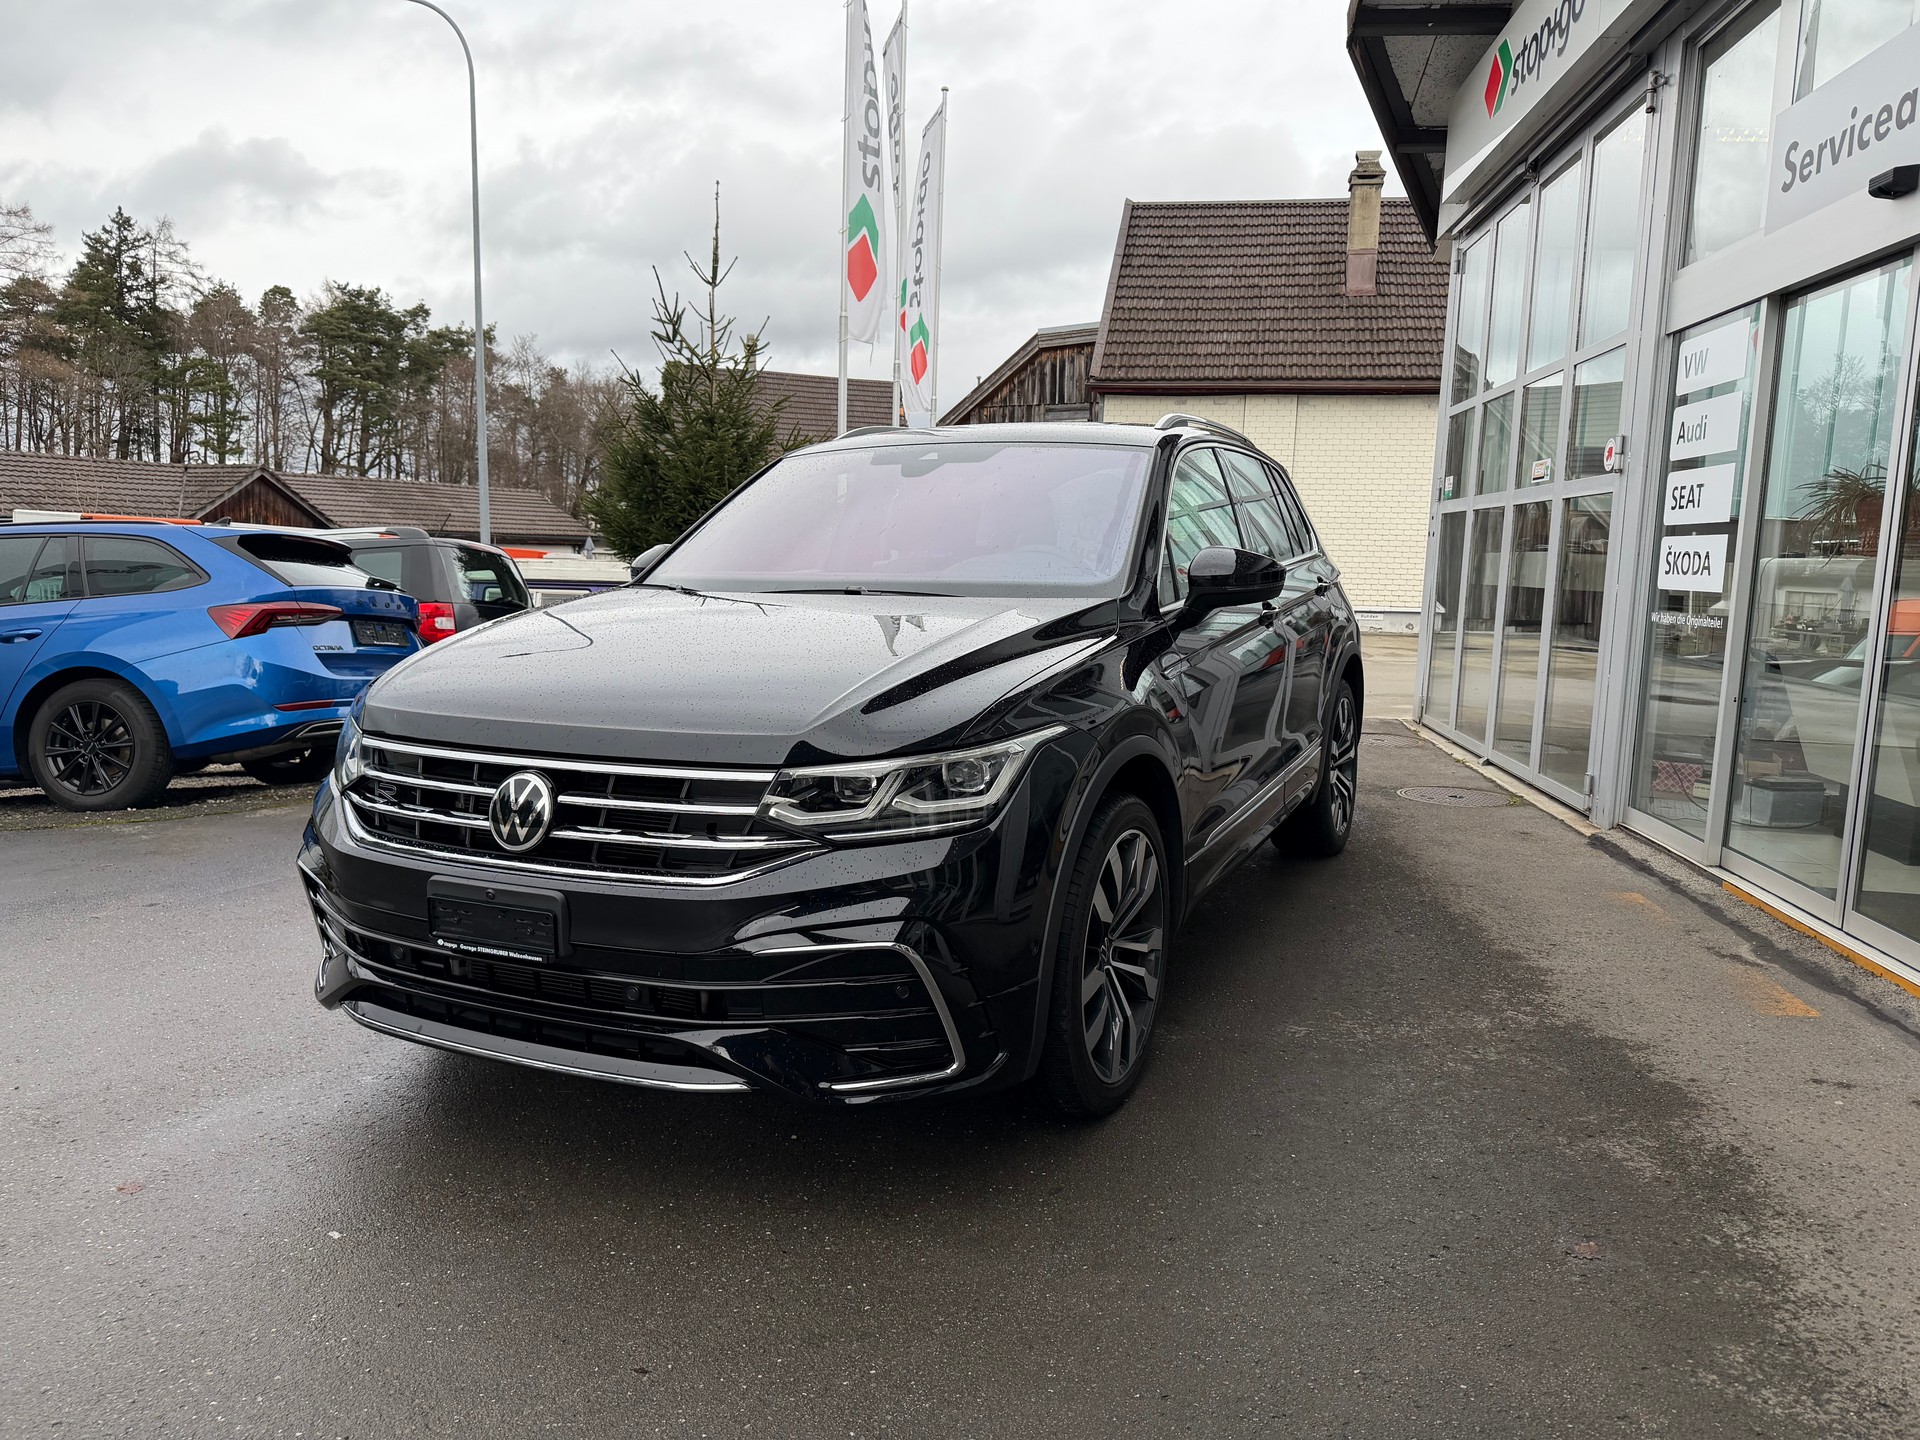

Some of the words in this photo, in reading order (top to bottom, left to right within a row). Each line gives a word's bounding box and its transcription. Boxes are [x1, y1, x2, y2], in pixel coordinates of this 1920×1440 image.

[1780, 87, 1919, 193] Servicea
[1684, 347, 1709, 380] VW
[1676, 414, 1708, 446] Audi
[1670, 483, 1705, 511] SEAT
[1664, 545, 1712, 577] ŠKODA
[1651, 611, 1660, 622] Wir
[1660, 613, 1677, 624] haben
[1676, 613, 1686, 625] die
[312, 644, 344, 652] OCTAVIA
[459, 943, 477, 953] Garage
[477, 946, 509, 957] STEINGRUBER
